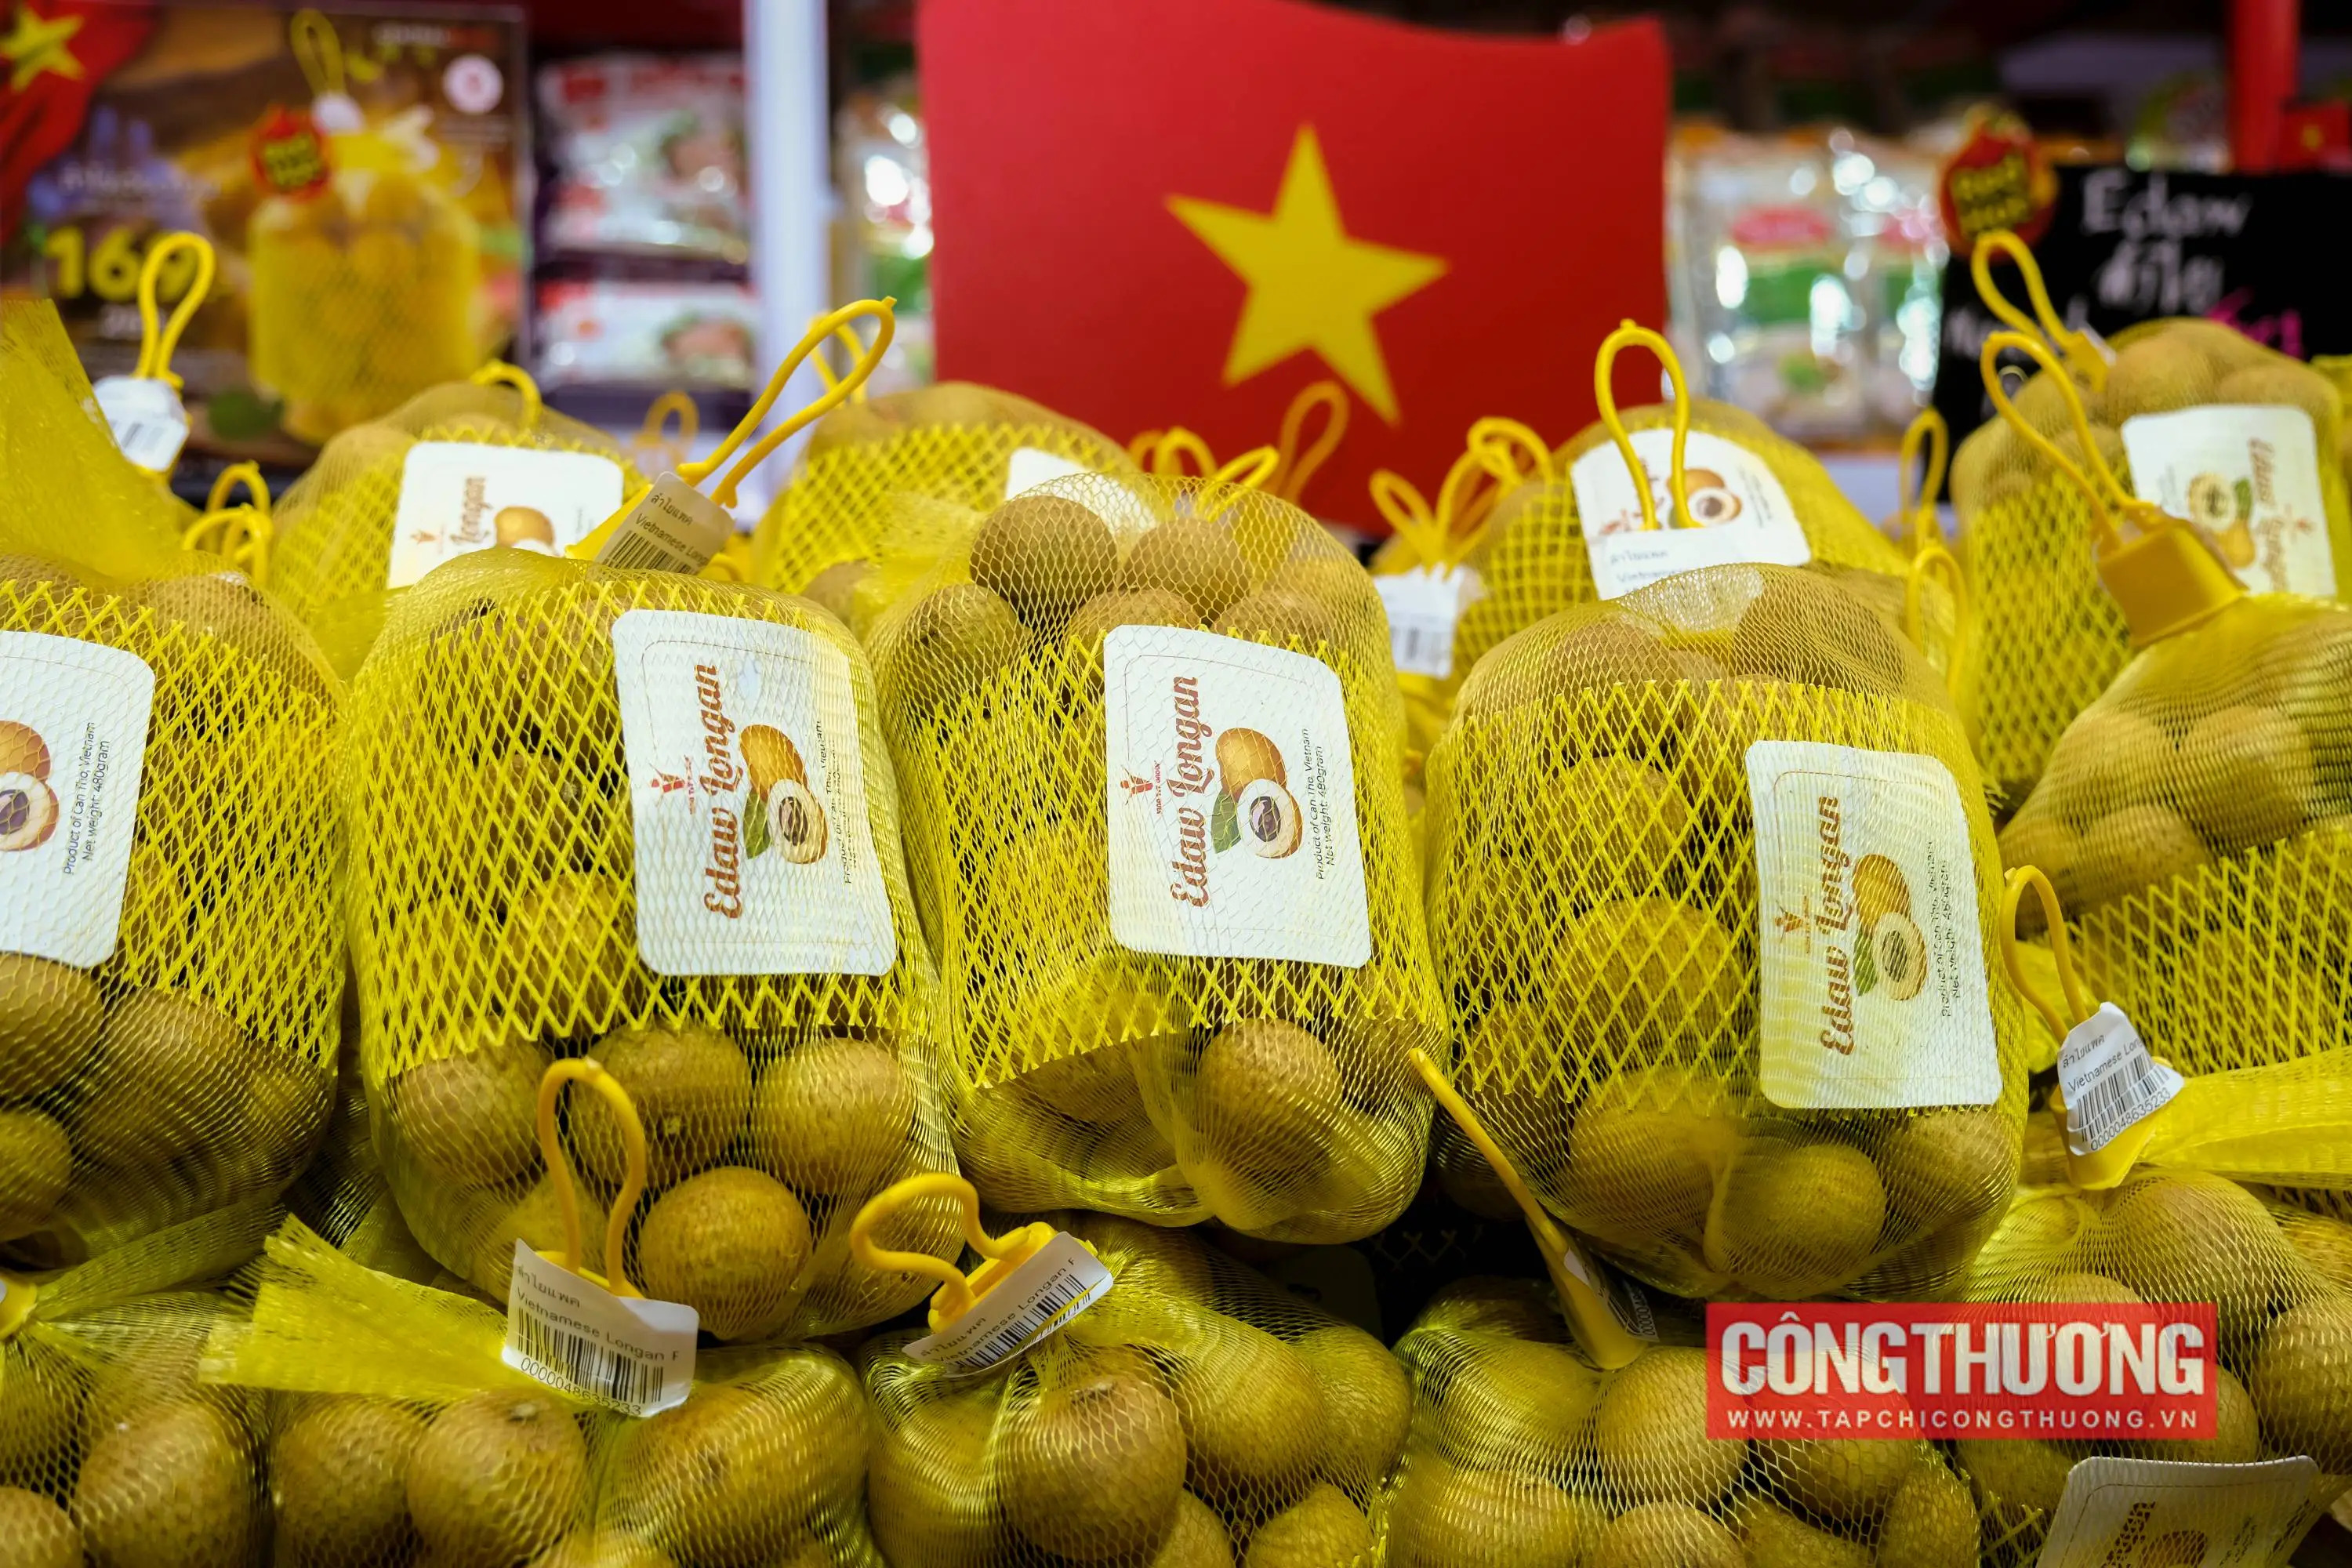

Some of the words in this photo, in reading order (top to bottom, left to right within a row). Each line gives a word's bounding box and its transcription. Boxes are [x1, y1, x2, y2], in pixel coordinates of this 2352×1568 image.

[636, 514, 688, 553] Vietnamese
[79, 721, 95, 768] Vietnam
[694, 664, 743, 797] Longan
[1167, 677, 1214, 797] Longan
[1302, 728, 1313, 772] Vietnam
[1317, 746, 1328, 798] 480gram
[70, 815, 82, 829] of
[74, 793, 85, 815] Can
[82, 840, 96, 862] Net
[93, 739, 110, 793] 480gram
[1310, 800, 1319, 820] Can
[1312, 821, 1320, 834] of
[64, 830, 80, 876] Product
[705, 807, 743, 919] Edaw
[1171, 807, 1210, 908] Edaw
[1312, 835, 1324, 880] Product
[1816, 797, 1852, 935] Longan
[1820, 945, 1855, 1055] Edaw
[2068, 1053, 2122, 1092] Vietnamese
[517, 1287, 600, 1337] Vietnamese
[606, 1331, 665, 1361] Longan
[933, 1312, 1016, 1362] Vietnamese
[1018, 1267, 1066, 1311] Longan
